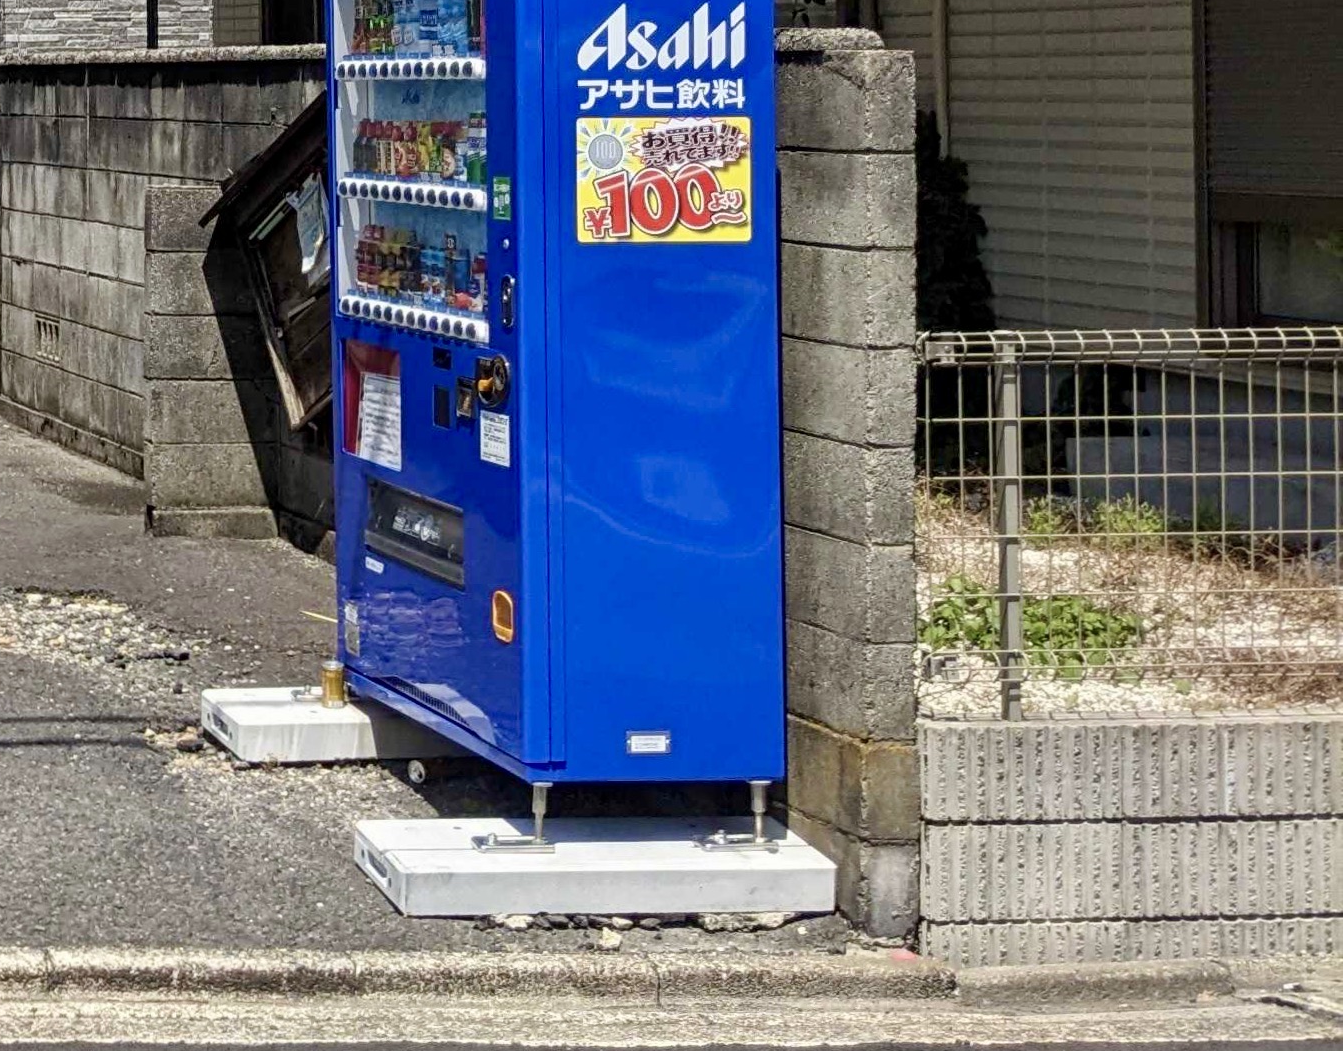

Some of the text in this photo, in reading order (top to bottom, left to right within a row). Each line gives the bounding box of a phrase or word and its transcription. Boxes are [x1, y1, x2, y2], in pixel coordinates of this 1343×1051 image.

[577, 2, 746, 71] Asahi
[577, 78, 746, 110] アサヒ飲料
[641, 123, 739, 149] お買得!!
[644, 144, 742, 167] 売れてます!!
